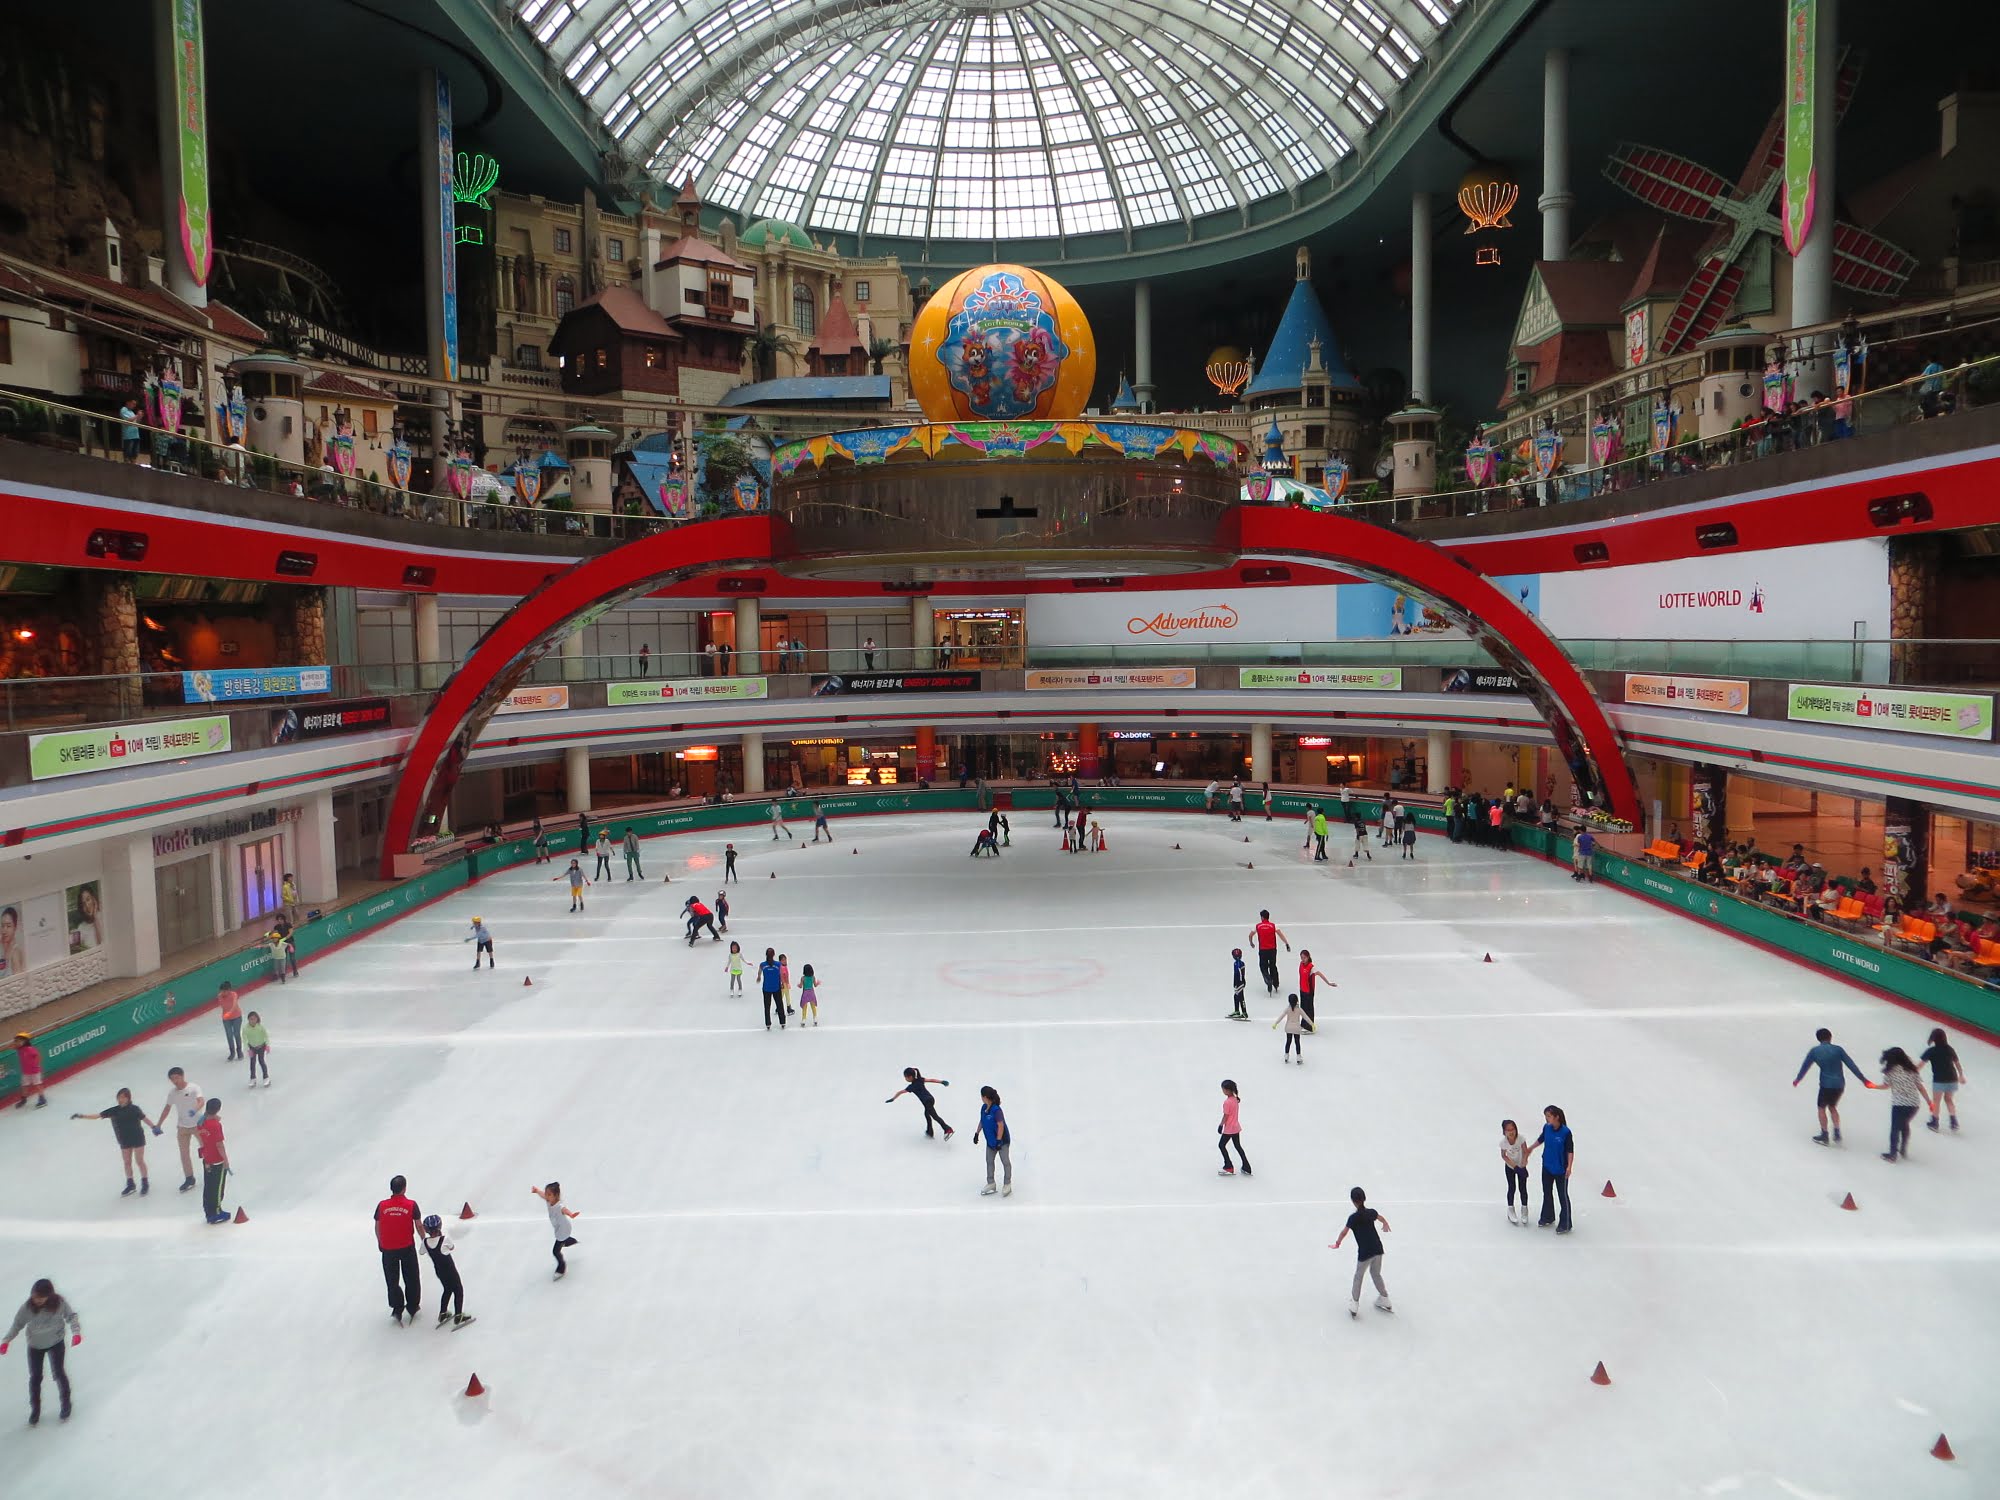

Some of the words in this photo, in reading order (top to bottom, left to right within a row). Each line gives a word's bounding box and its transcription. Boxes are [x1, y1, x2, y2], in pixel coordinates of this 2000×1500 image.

[1659, 592, 1695, 609] LOTTE
[1697, 589, 1742, 608] WORLD
[1128, 611, 1237, 637] Adventure
[224, 678, 260, 696] 방학특강
[263, 676, 297, 692] 회원모집
[851, 679, 875, 689] 에너지가
[876, 679, 895, 689] 필요할
[1040, 676, 1063, 684] 롯데리아
[1251, 675, 1274, 683] 홈플러스
[1797, 696, 1832, 713] 신세계백화점
[1874, 702, 1889, 716] 10배
[60, 744, 95, 763] SK텔레콤
[128, 738, 144, 753] 10배
[145, 735, 162, 751] 적립!
[1304, 736, 1332, 744] Saboten
[152, 829, 190, 857] World
[193, 819, 250, 846] Premium
[251, 808, 277, 831] Mall
[1644, 878, 1658, 889] LOTTE
[1657, 883, 1674, 893] WORLD
[367, 904, 381, 917] LOTTE
[380, 899, 395, 910] WORLD
[240, 959, 260, 972] LOTTE
[1832, 948, 1855, 964] LOTTE
[1855, 957, 1880, 973] WORLD
[48, 1037, 78, 1058] LOTTE
[77, 1025, 107, 1045] WORLD
